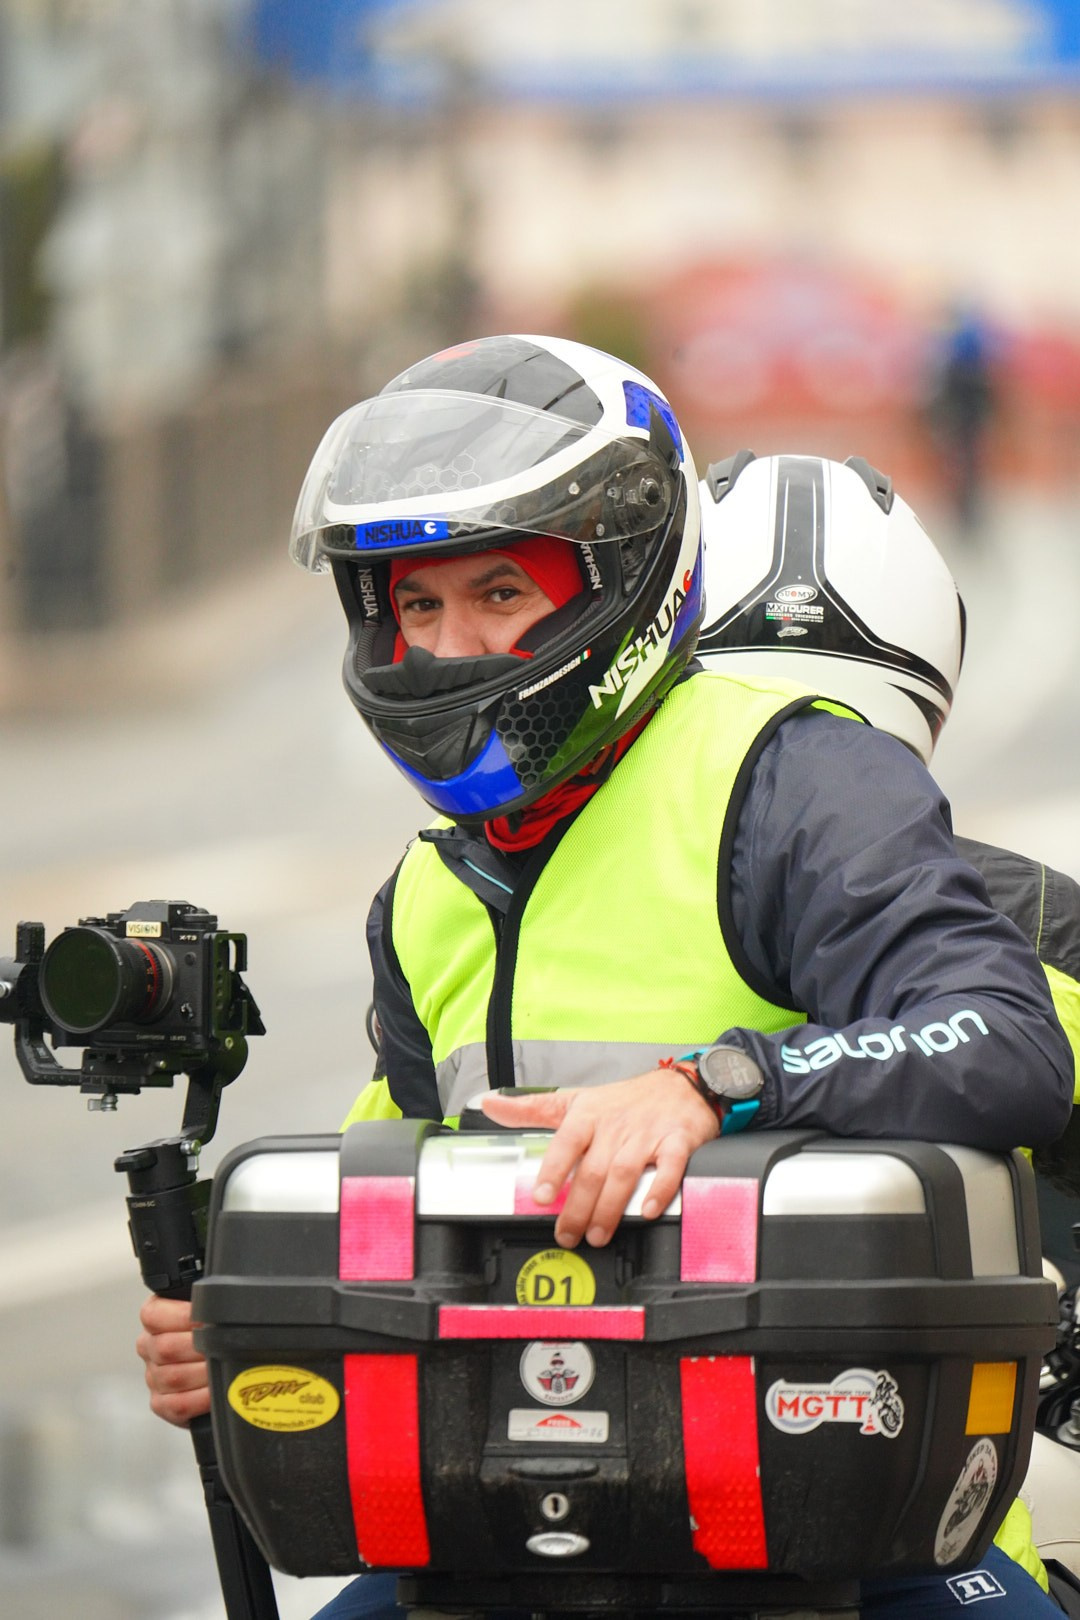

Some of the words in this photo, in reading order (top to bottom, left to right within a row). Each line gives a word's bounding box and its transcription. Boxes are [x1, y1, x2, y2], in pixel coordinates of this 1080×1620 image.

[364, 520, 425, 545] NISHUA
[580, 543, 603, 590] NISHUA
[358, 568, 379, 617] NISHUA
[779, 590, 813, 598] SUOMY
[588, 588, 686, 710] NISHUA
[128, 924, 158, 934] VISION
[533, 1274, 572, 1305] D1
[777, 1395, 869, 1418] MGTT
